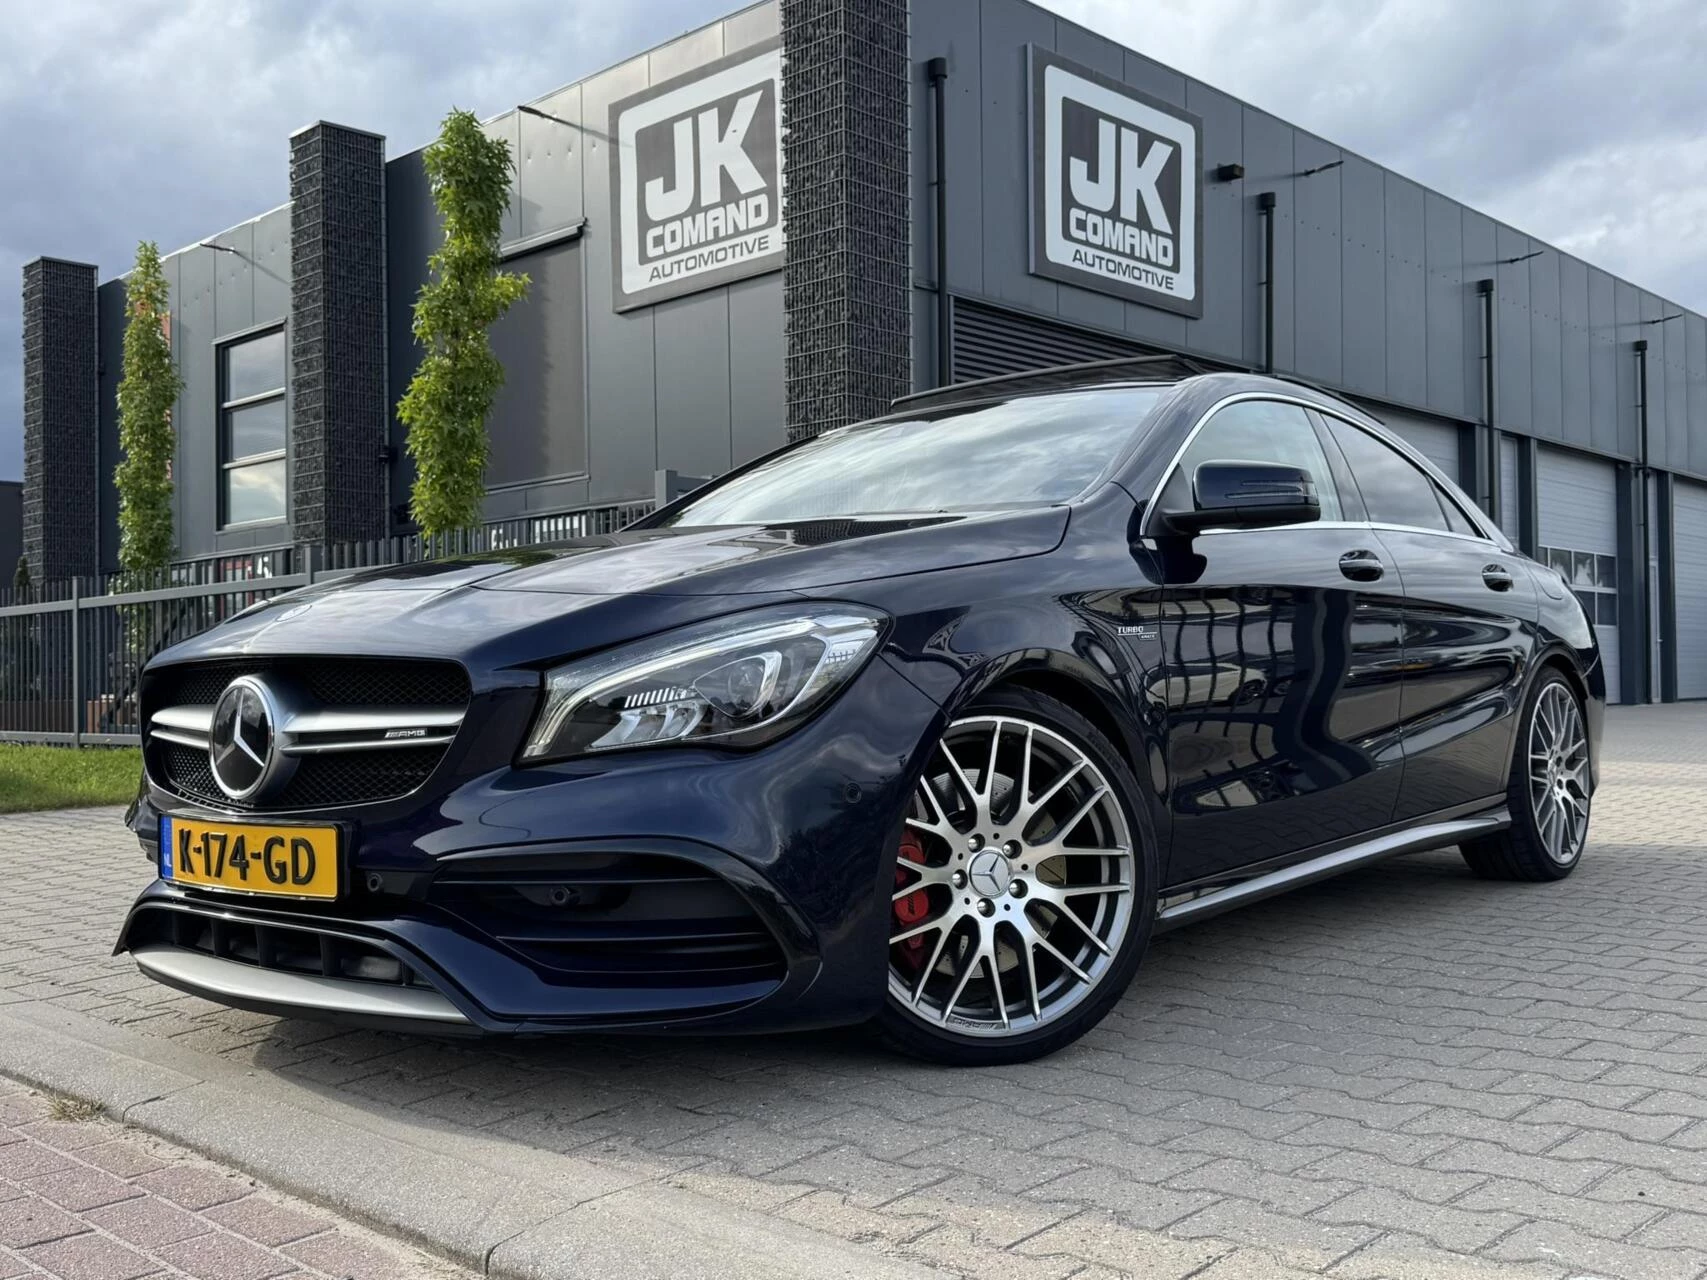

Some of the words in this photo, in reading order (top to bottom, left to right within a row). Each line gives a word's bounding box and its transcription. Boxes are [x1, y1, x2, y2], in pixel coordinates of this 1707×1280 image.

[645, 89, 768, 222] JK
[1069, 118, 1174, 235] JK
[646, 193, 769, 259] COMAND
[1069, 207, 1174, 268] COMAND
[649, 235, 769, 282] AUTOMOTIVE
[1072, 249, 1174, 290] AUTOMOTIVE
[1118, 626, 1144, 634] TURBO
[397, 729, 426, 738] AMG
[178, 828, 316, 885] K-174-GD
